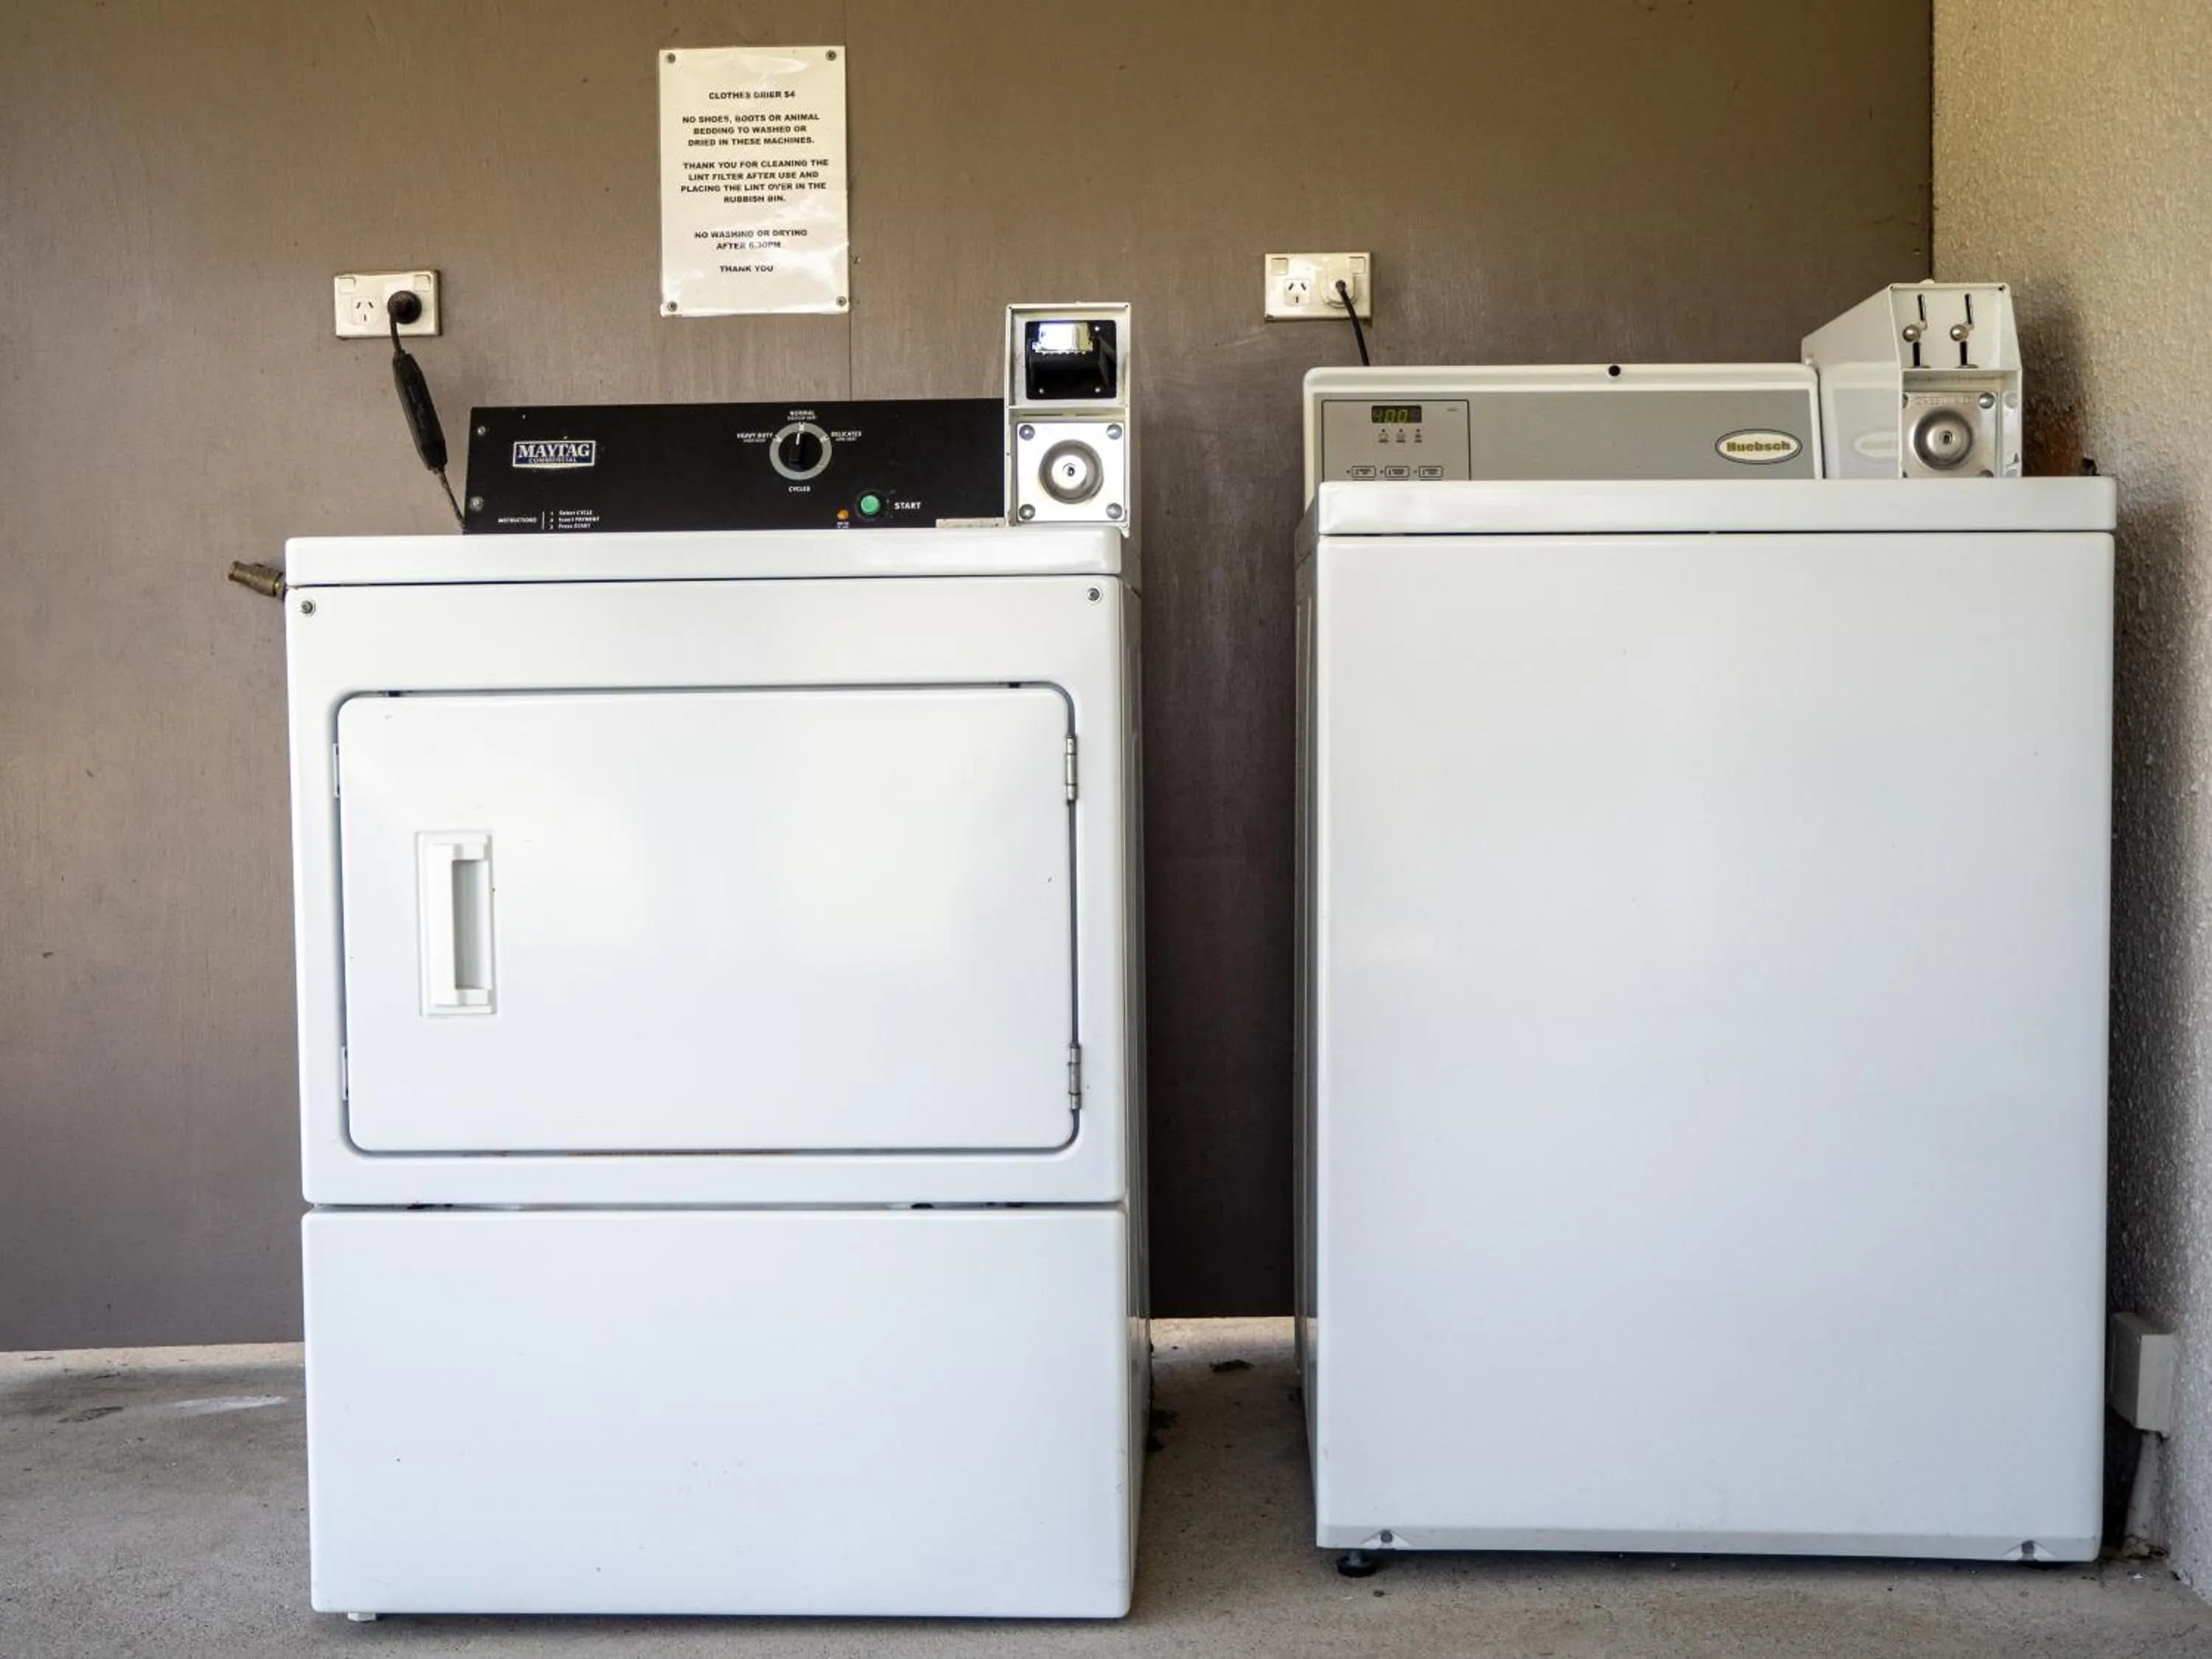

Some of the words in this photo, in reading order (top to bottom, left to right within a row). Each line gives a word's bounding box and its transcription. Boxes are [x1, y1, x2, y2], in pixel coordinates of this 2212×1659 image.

[709, 91, 751, 100] CLOTHES
[754, 91, 782, 99] DRIER
[682, 116, 696, 124] NO
[698, 115, 732, 124] SHOES,
[734, 114, 766, 122] BOOTS
[693, 127, 734, 135] BEDDING
[751, 125, 791, 133] WASHED
[793, 125, 807, 133] OR
[688, 139, 716, 147] DRIED
[731, 137, 762, 146] THESE
[763, 136, 815, 145] MACHINES.
[683, 161, 714, 170] THANK
[718, 161, 737, 169] YOU
[760, 159, 807, 167] CLEANING
[810, 159, 829, 167] THE
[778, 171, 796, 179] USE
[799, 170, 819, 178] AND
[681, 184, 720, 192] PLACING
[723, 184, 741, 192] THE
[710, 230, 754, 238] WASHING
[518, 443, 591, 458] MAYTAG
